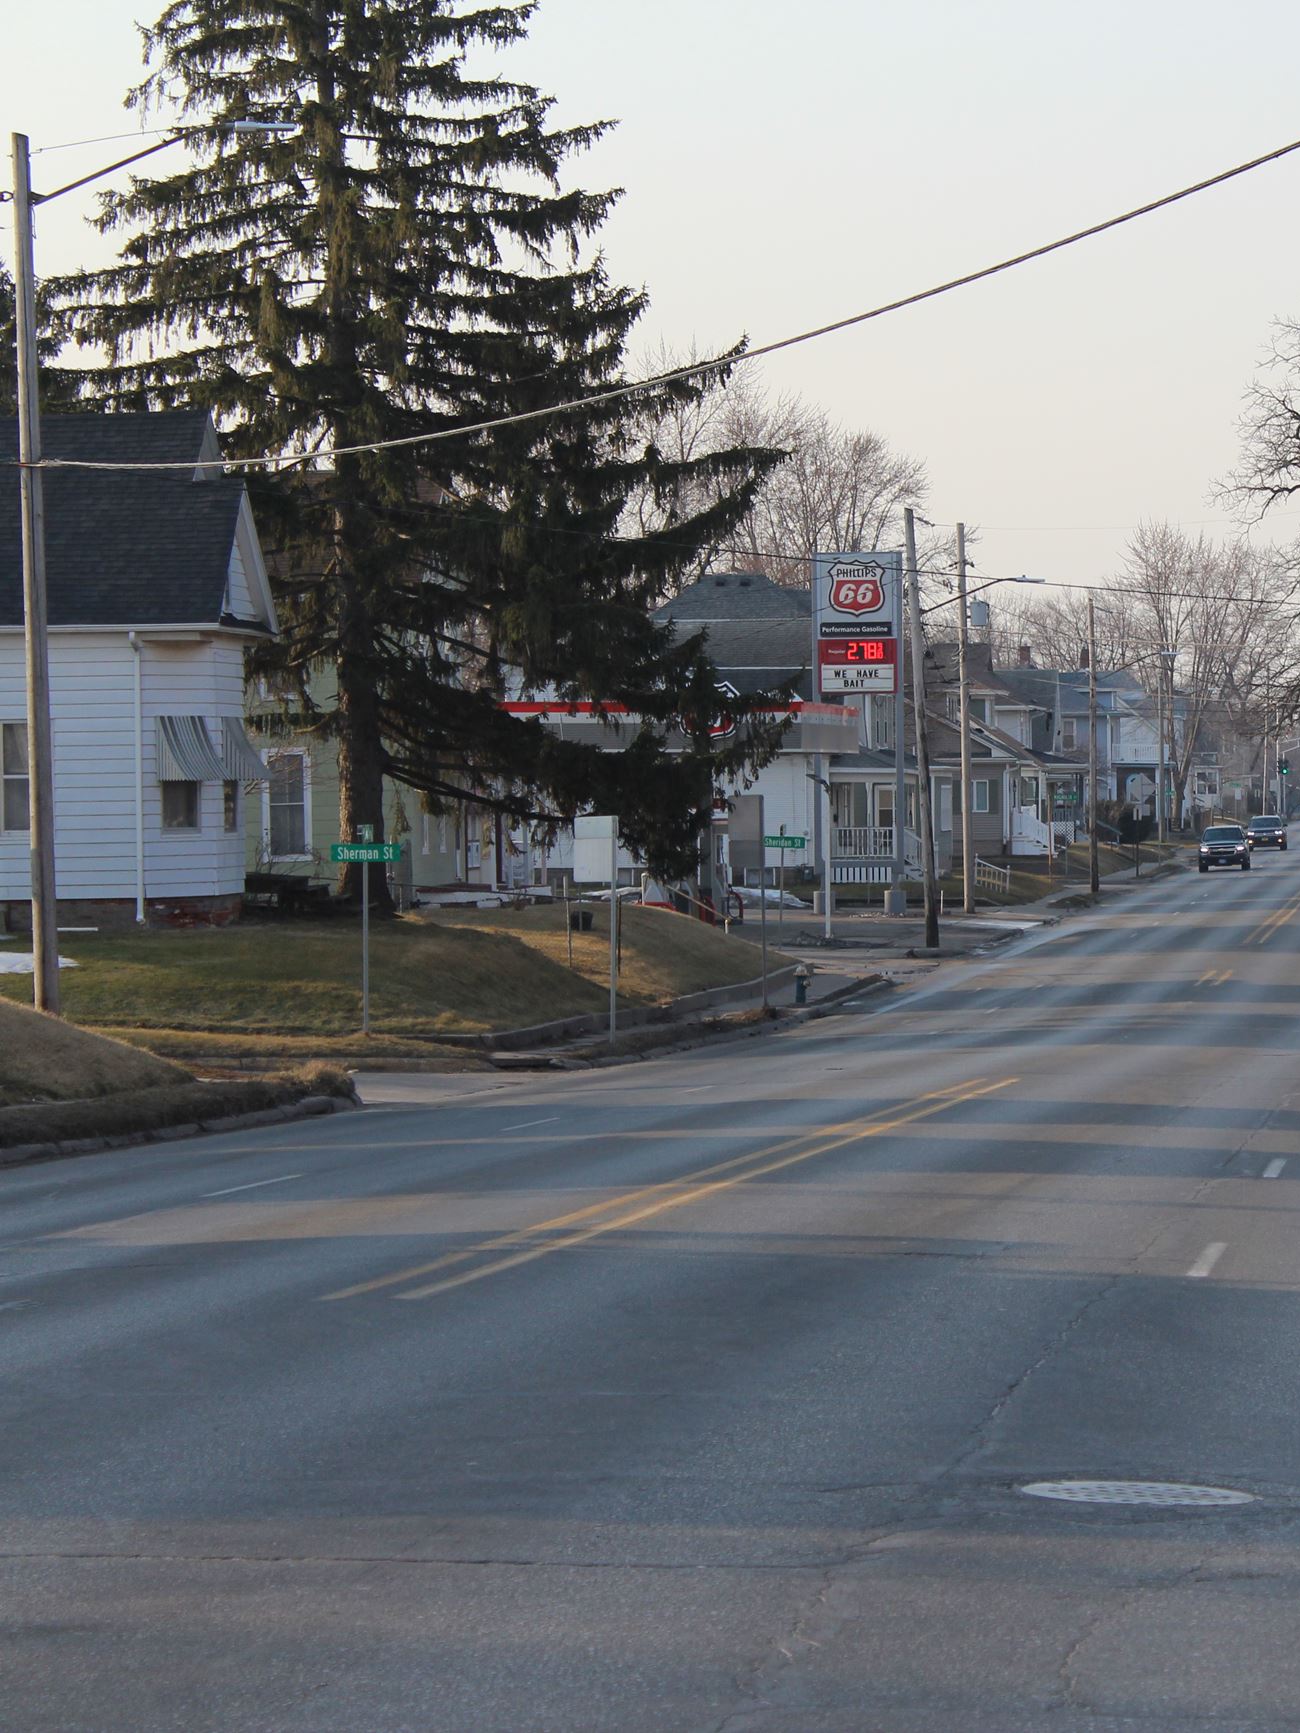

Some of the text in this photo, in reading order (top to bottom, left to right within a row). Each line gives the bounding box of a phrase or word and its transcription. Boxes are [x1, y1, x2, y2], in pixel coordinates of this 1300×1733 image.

[836, 568, 877, 578] PHILLIPS
[838, 583, 874, 605] 66
[861, 625, 888, 633] Gasoline
[834, 669, 879, 678] WE HAVE
[764, 837, 801, 847] Sheridan St
[337, 846, 393, 860] Sherman St
